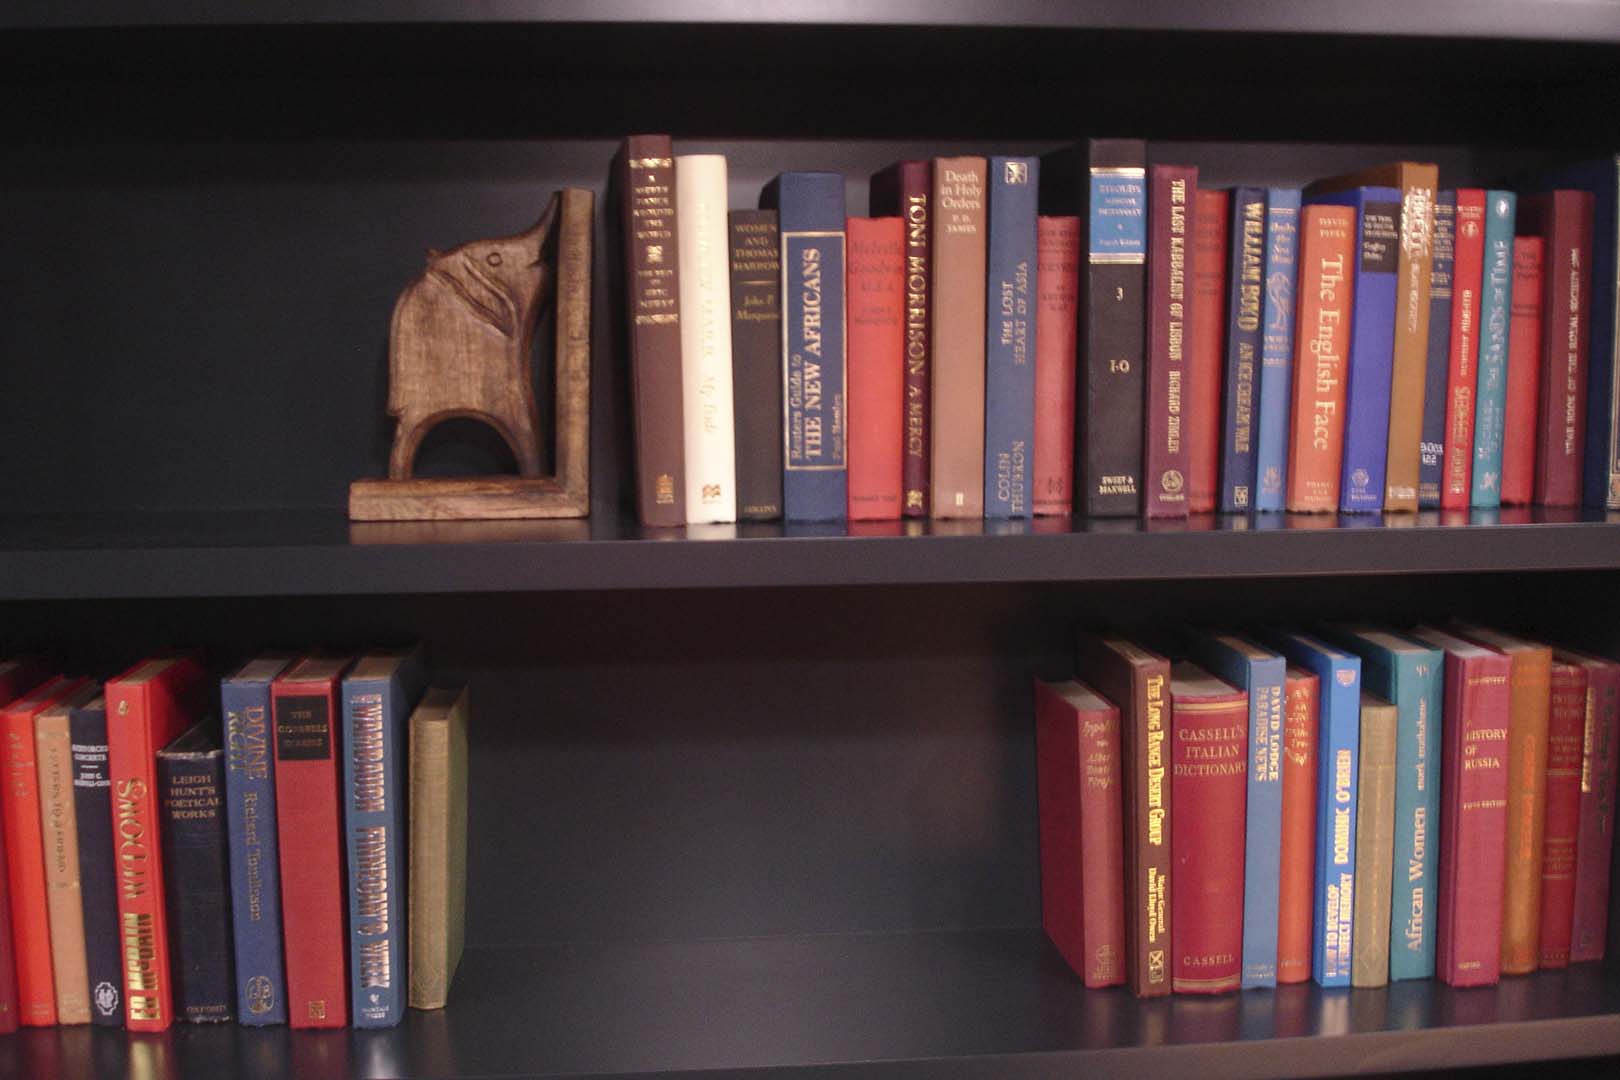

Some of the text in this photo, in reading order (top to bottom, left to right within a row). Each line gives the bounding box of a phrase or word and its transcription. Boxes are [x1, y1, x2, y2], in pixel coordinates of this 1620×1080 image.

[941, 185, 982, 199] in Holy
[945, 169, 979, 184] Death
[1171, 178, 1186, 204] THE
[941, 198, 982, 210] Orders
[1171, 205, 1186, 235] LAST
[735, 223, 778, 233] WOMEN
[745, 237, 769, 246] AND
[946, 224, 978, 234] JAMES
[1241, 202, 1265, 281] WILLIAM
[734, 262, 780, 272] HARROW
[735, 249, 779, 258] THOMAS
[1490, 240, 1509, 285] TIME
[1016, 260, 1029, 294] ASIA
[1570, 270, 1581, 312] SOCIETY
[1001, 281, 1014, 346] THE LOST
[1016, 298, 1027, 316] OF
[1169, 302, 1184, 319] OF
[1237, 283, 1261, 332] BOYD
[907, 193, 927, 459] TONI MORRISON A MERCY
[1168, 321, 1184, 362] LISBON
[802, 247, 823, 461] THE NEW AFRICANS
[1310, 253, 1344, 451] The English Face
[790, 369, 802, 409] Guide
[1167, 370, 1182, 415] RICHARD
[1566, 394, 1577, 424] BOOK
[790, 410, 802, 461] Reuters
[1167, 415, 1181, 454] ZIMLER
[998, 453, 1011, 502] COLIN
[1099, 485, 1137, 495] MAXWELL
[1101, 475, 1126, 484] SWEET
[227, 711, 248, 771] RIGHT
[246, 704, 268, 780] DIVINE
[1179, 725, 1246, 742] CASSELL'S
[1185, 744, 1240, 759] ITALIAN
[1254, 687, 1269, 782] PARADISE NEWS
[1268, 686, 1281, 782] DAVID LODGE
[1464, 744, 1477, 756] OF
[1465, 728, 1508, 741] HISTORY
[1147, 675, 1166, 846] THE LONG RANGE DESERT GROUP
[1174, 762, 1247, 777] DICTIONARY
[1335, 749, 1352, 803] O'BRIEN
[1464, 756, 1501, 771] RUSSIA
[170, 786, 216, 797] HUNT'S
[172, 775, 212, 785] LEIGH
[165, 797, 220, 808] POETICAL
[172, 809, 216, 820] WORKS
[244, 792, 262, 922] Richard Tomlinson
[351, 703, 391, 989] WAMBAUGH FINNEGAN'S WEEK
[1408, 808, 1426, 882] Women
[116, 777, 161, 1020] ED McBAIN WIDOWS
[1147, 867, 1158, 944] David Lloyd Owen
[1327, 884, 1340, 931] DEVELOP
[1339, 873, 1353, 922] MEMORY
[1404, 887, 1424, 952] African
[1326, 931, 1338, 946] TO
[1183, 954, 1235, 967] CASSELL
